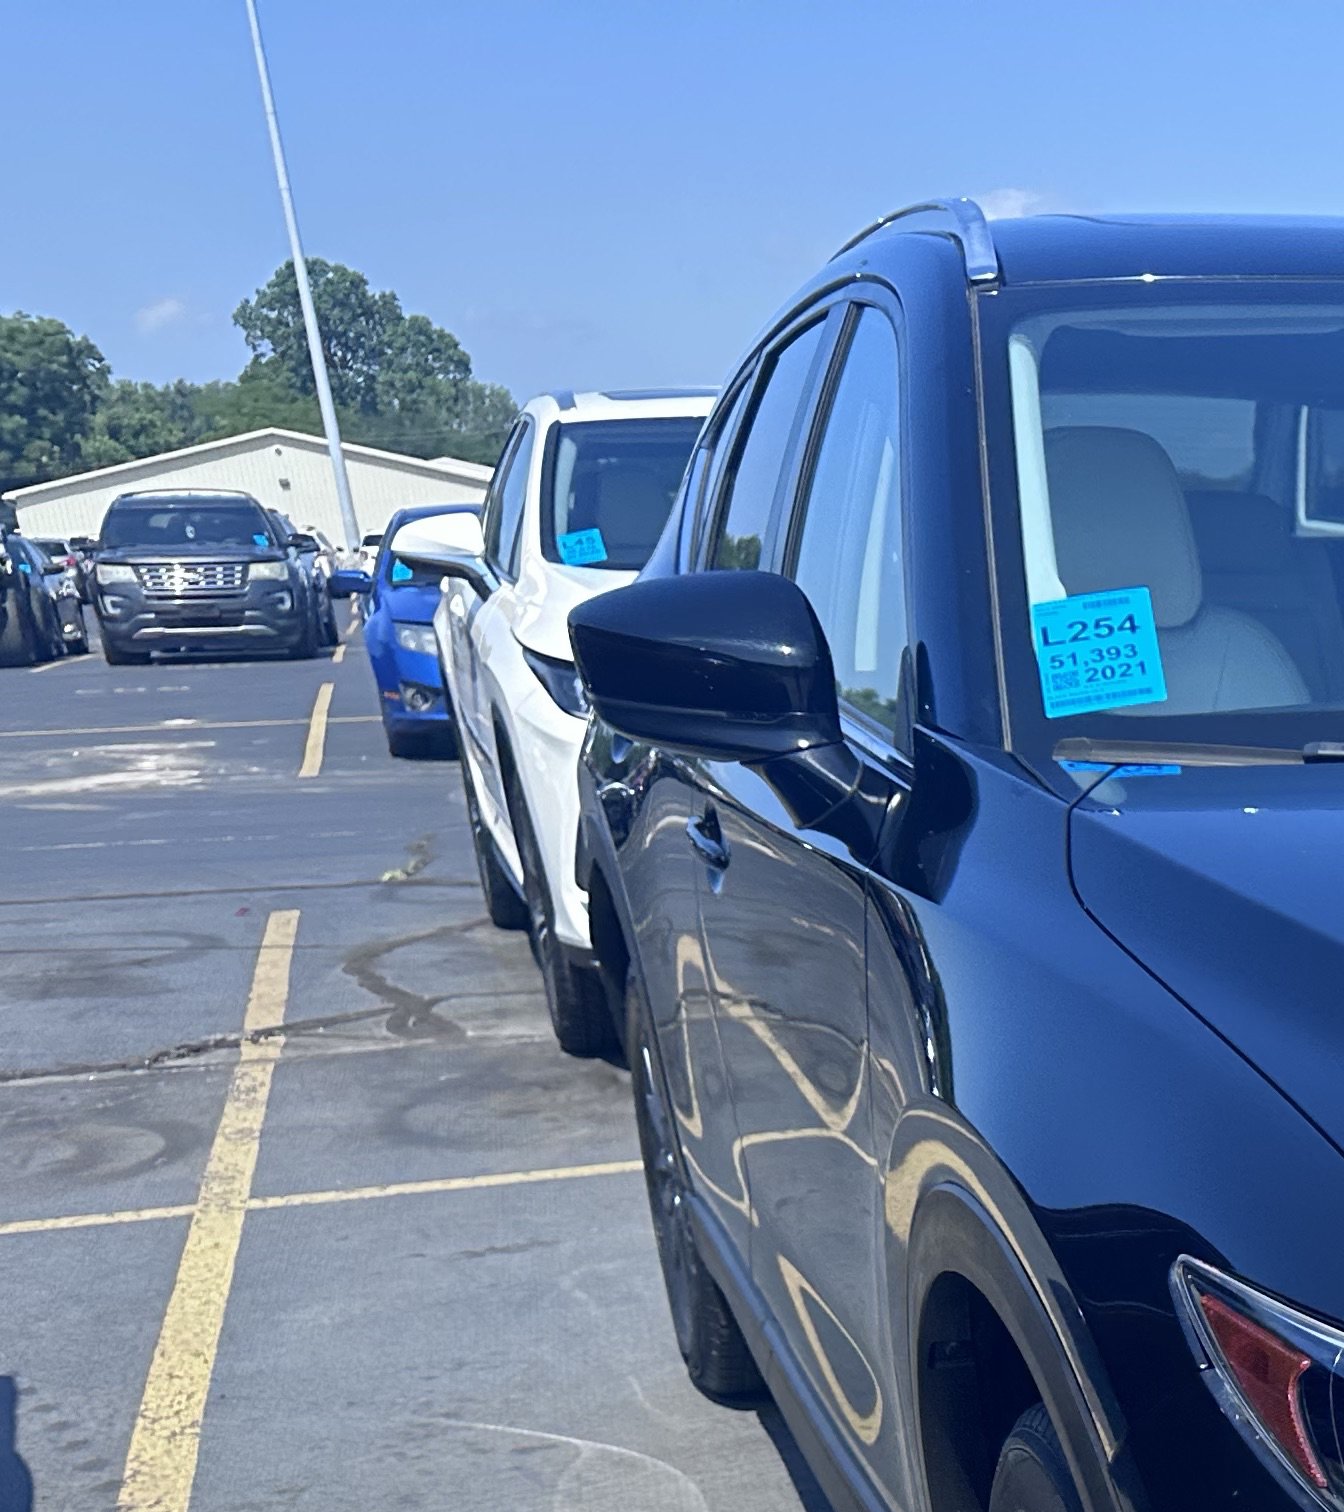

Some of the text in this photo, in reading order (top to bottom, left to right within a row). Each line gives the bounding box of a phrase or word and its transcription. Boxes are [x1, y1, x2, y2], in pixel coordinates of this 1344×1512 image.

[1040, 613, 1141, 647] L254
[1049, 643, 1138, 670] 51,393
[1084, 661, 1147, 683] 2021
